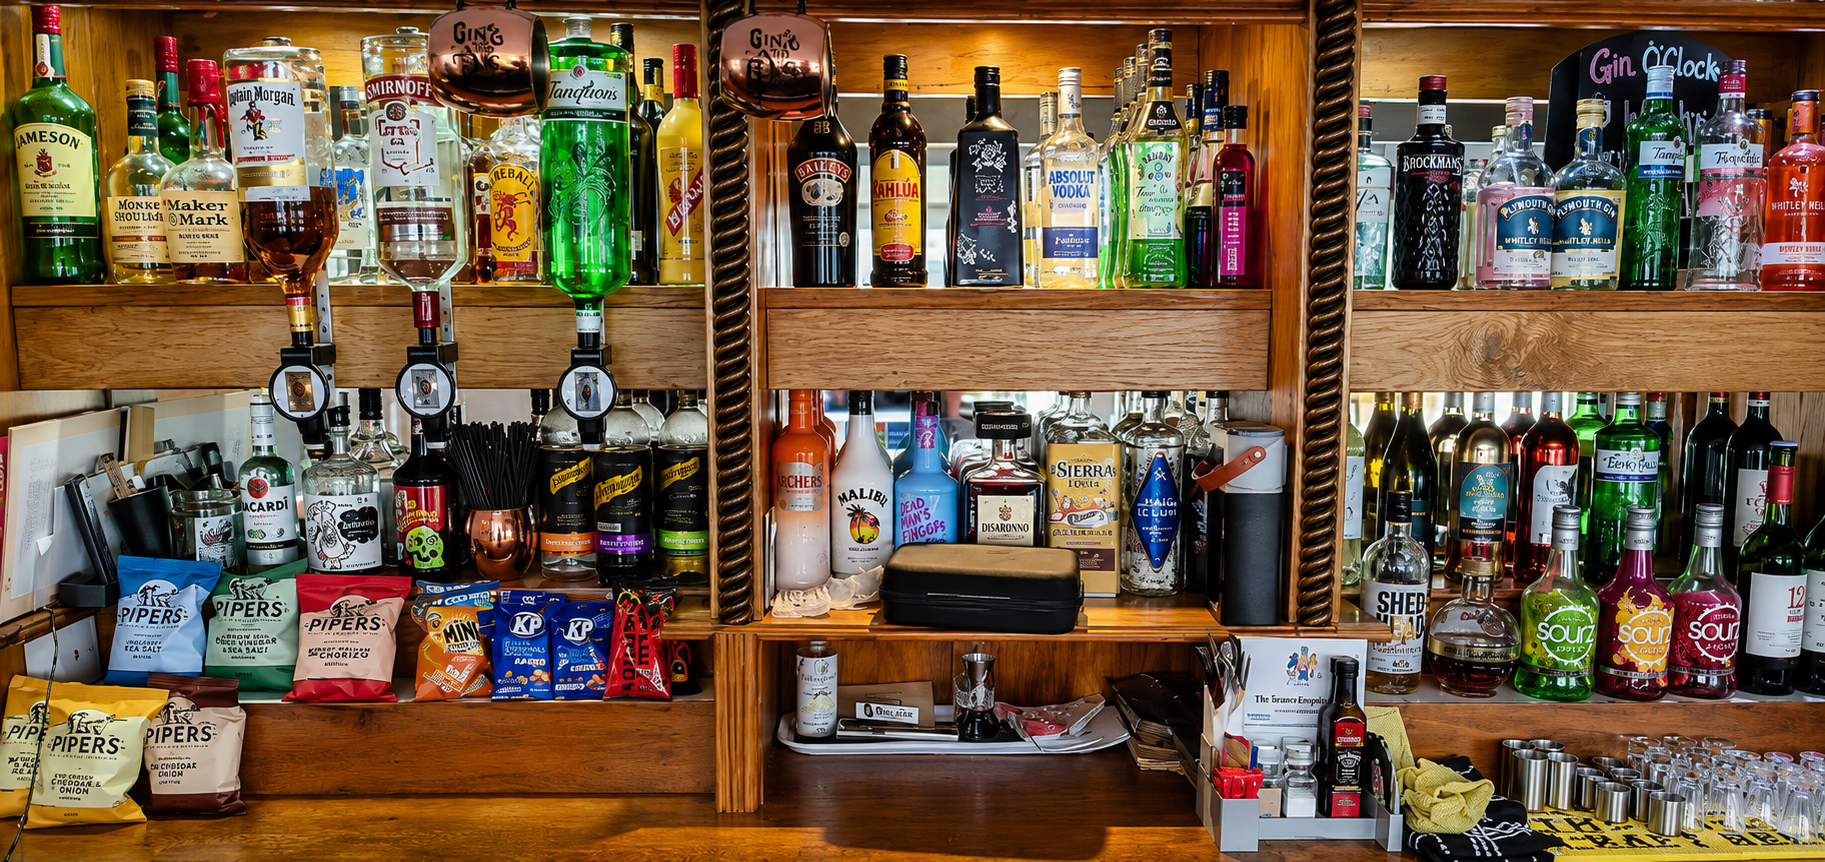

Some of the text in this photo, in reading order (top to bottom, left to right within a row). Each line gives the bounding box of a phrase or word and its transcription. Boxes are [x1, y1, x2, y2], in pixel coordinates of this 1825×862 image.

[1589, 47, 1637, 85] Gin
[253, 85, 296, 107] Morgan
[366, 79, 433, 100] SMIRNOFF
[15, 130, 81, 150] JAMESON
[797, 160, 849, 179] BAILEYS
[1048, 170, 1096, 185] ABSOLUT
[1051, 185, 1091, 199] VODKA
[118, 199, 161, 211] MONKE
[167, 199, 229, 212] Maker
[178, 213, 229, 226] Mark
[1056, 460, 1112, 479] SIERRA
[776, 475, 822, 489] ARCHERS
[837, 487, 888, 507] MALIBU
[900, 497, 925, 516] DEAD
[900, 507, 931, 530] MAN'S
[981, 522, 1030, 533] DISARONNO
[1377, 591, 1425, 615] SHED
[1787, 585, 1805, 609] 12
[121, 606, 182, 625] PIPERS
[216, 600, 283, 618] PIPERS
[308, 616, 381, 632] PIPERS
[442, 620, 480, 644] MINI
[513, 615, 542, 636] KP
[567, 619, 594, 641] KP
[145, 725, 212, 745] PIPERS
[51, 735, 120, 755] PIPERS
[59, 786, 89, 795] ONION
